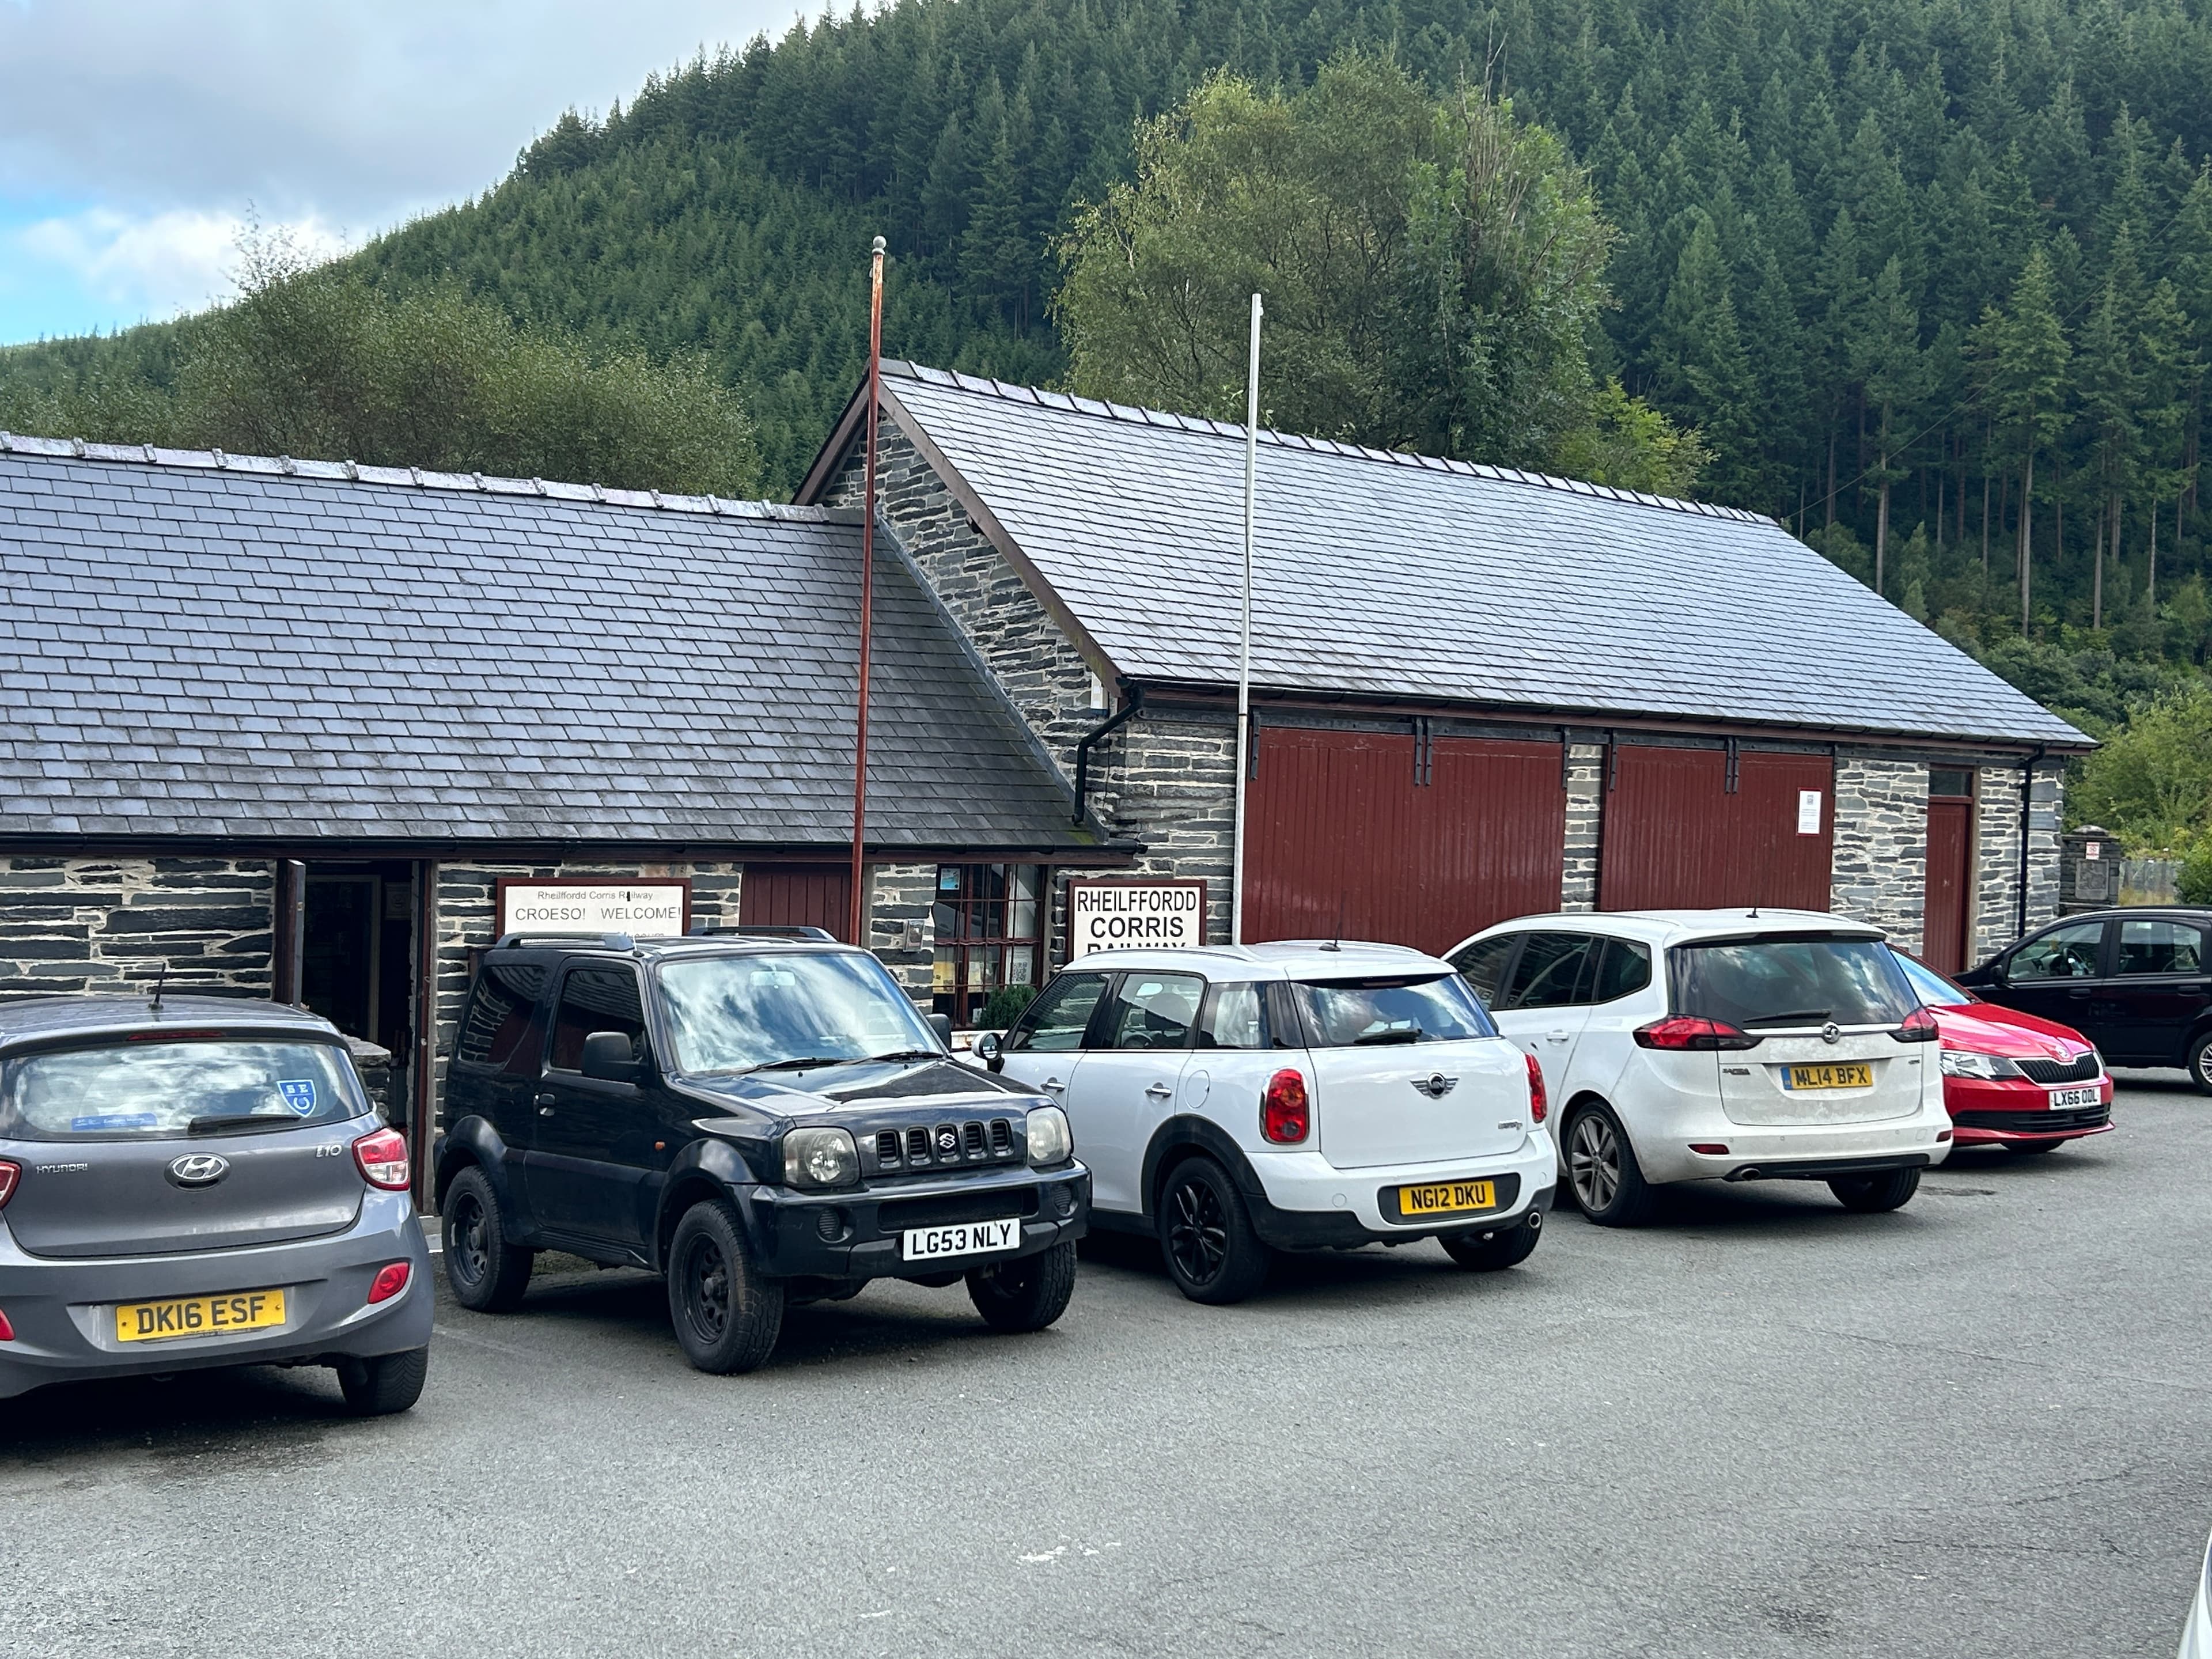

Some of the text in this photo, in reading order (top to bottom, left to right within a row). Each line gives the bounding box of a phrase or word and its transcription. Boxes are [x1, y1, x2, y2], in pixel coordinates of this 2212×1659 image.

[537, 891, 586, 900] Rheilffordd
[589, 891, 616, 900] Corris
[1078, 890, 1196, 912] RHEILFFORDD
[515, 906, 681, 921] CROESO! WELCOME!
[1090, 916, 1184, 938] CORRIS
[1794, 1067, 1832, 1086] ML14
[2054, 1090, 2080, 1107] LX66
[36, 1162, 88, 1175] HYUNDAI
[1411, 1184, 1486, 1210] NG12 DKU
[912, 1223, 1011, 1255] LG53 NLY
[136, 1296, 266, 1335] DK16 ESF
